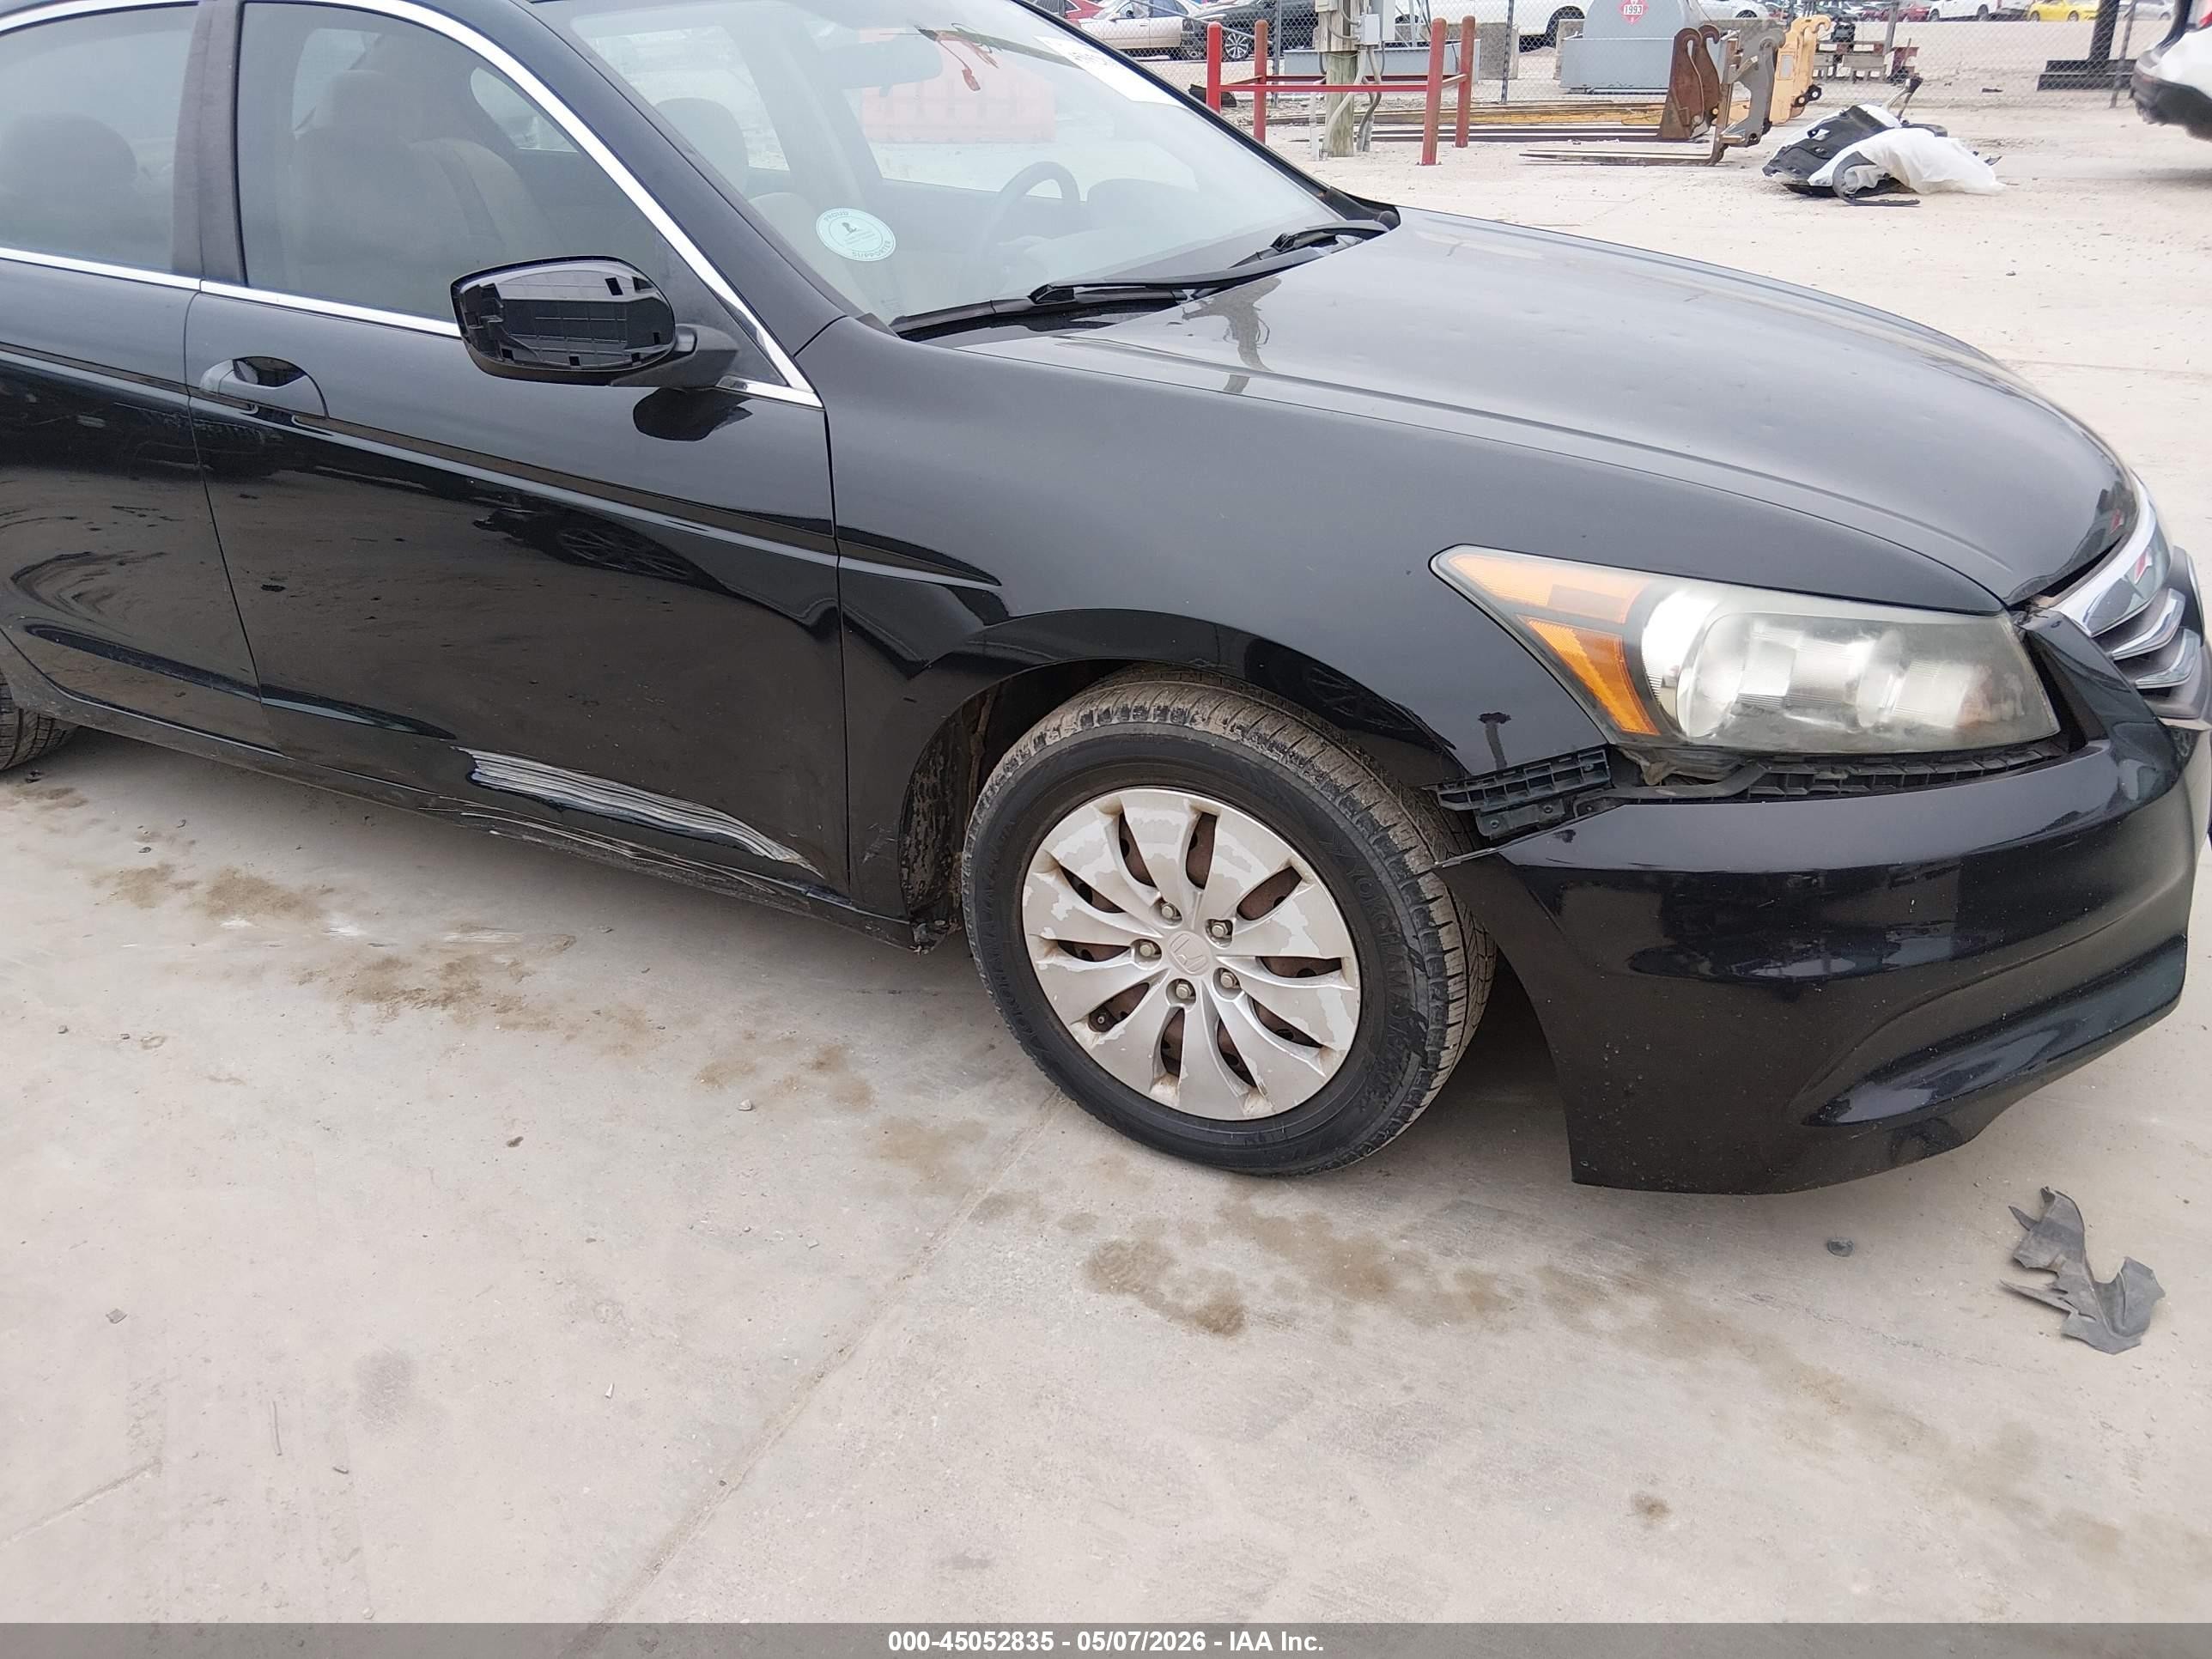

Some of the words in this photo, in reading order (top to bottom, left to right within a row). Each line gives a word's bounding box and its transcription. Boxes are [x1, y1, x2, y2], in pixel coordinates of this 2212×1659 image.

[1625, 5, 1642, 15] 1993
[823, 210, 849, 222] PROUD
[852, 240, 891, 258] SUPPORTER
